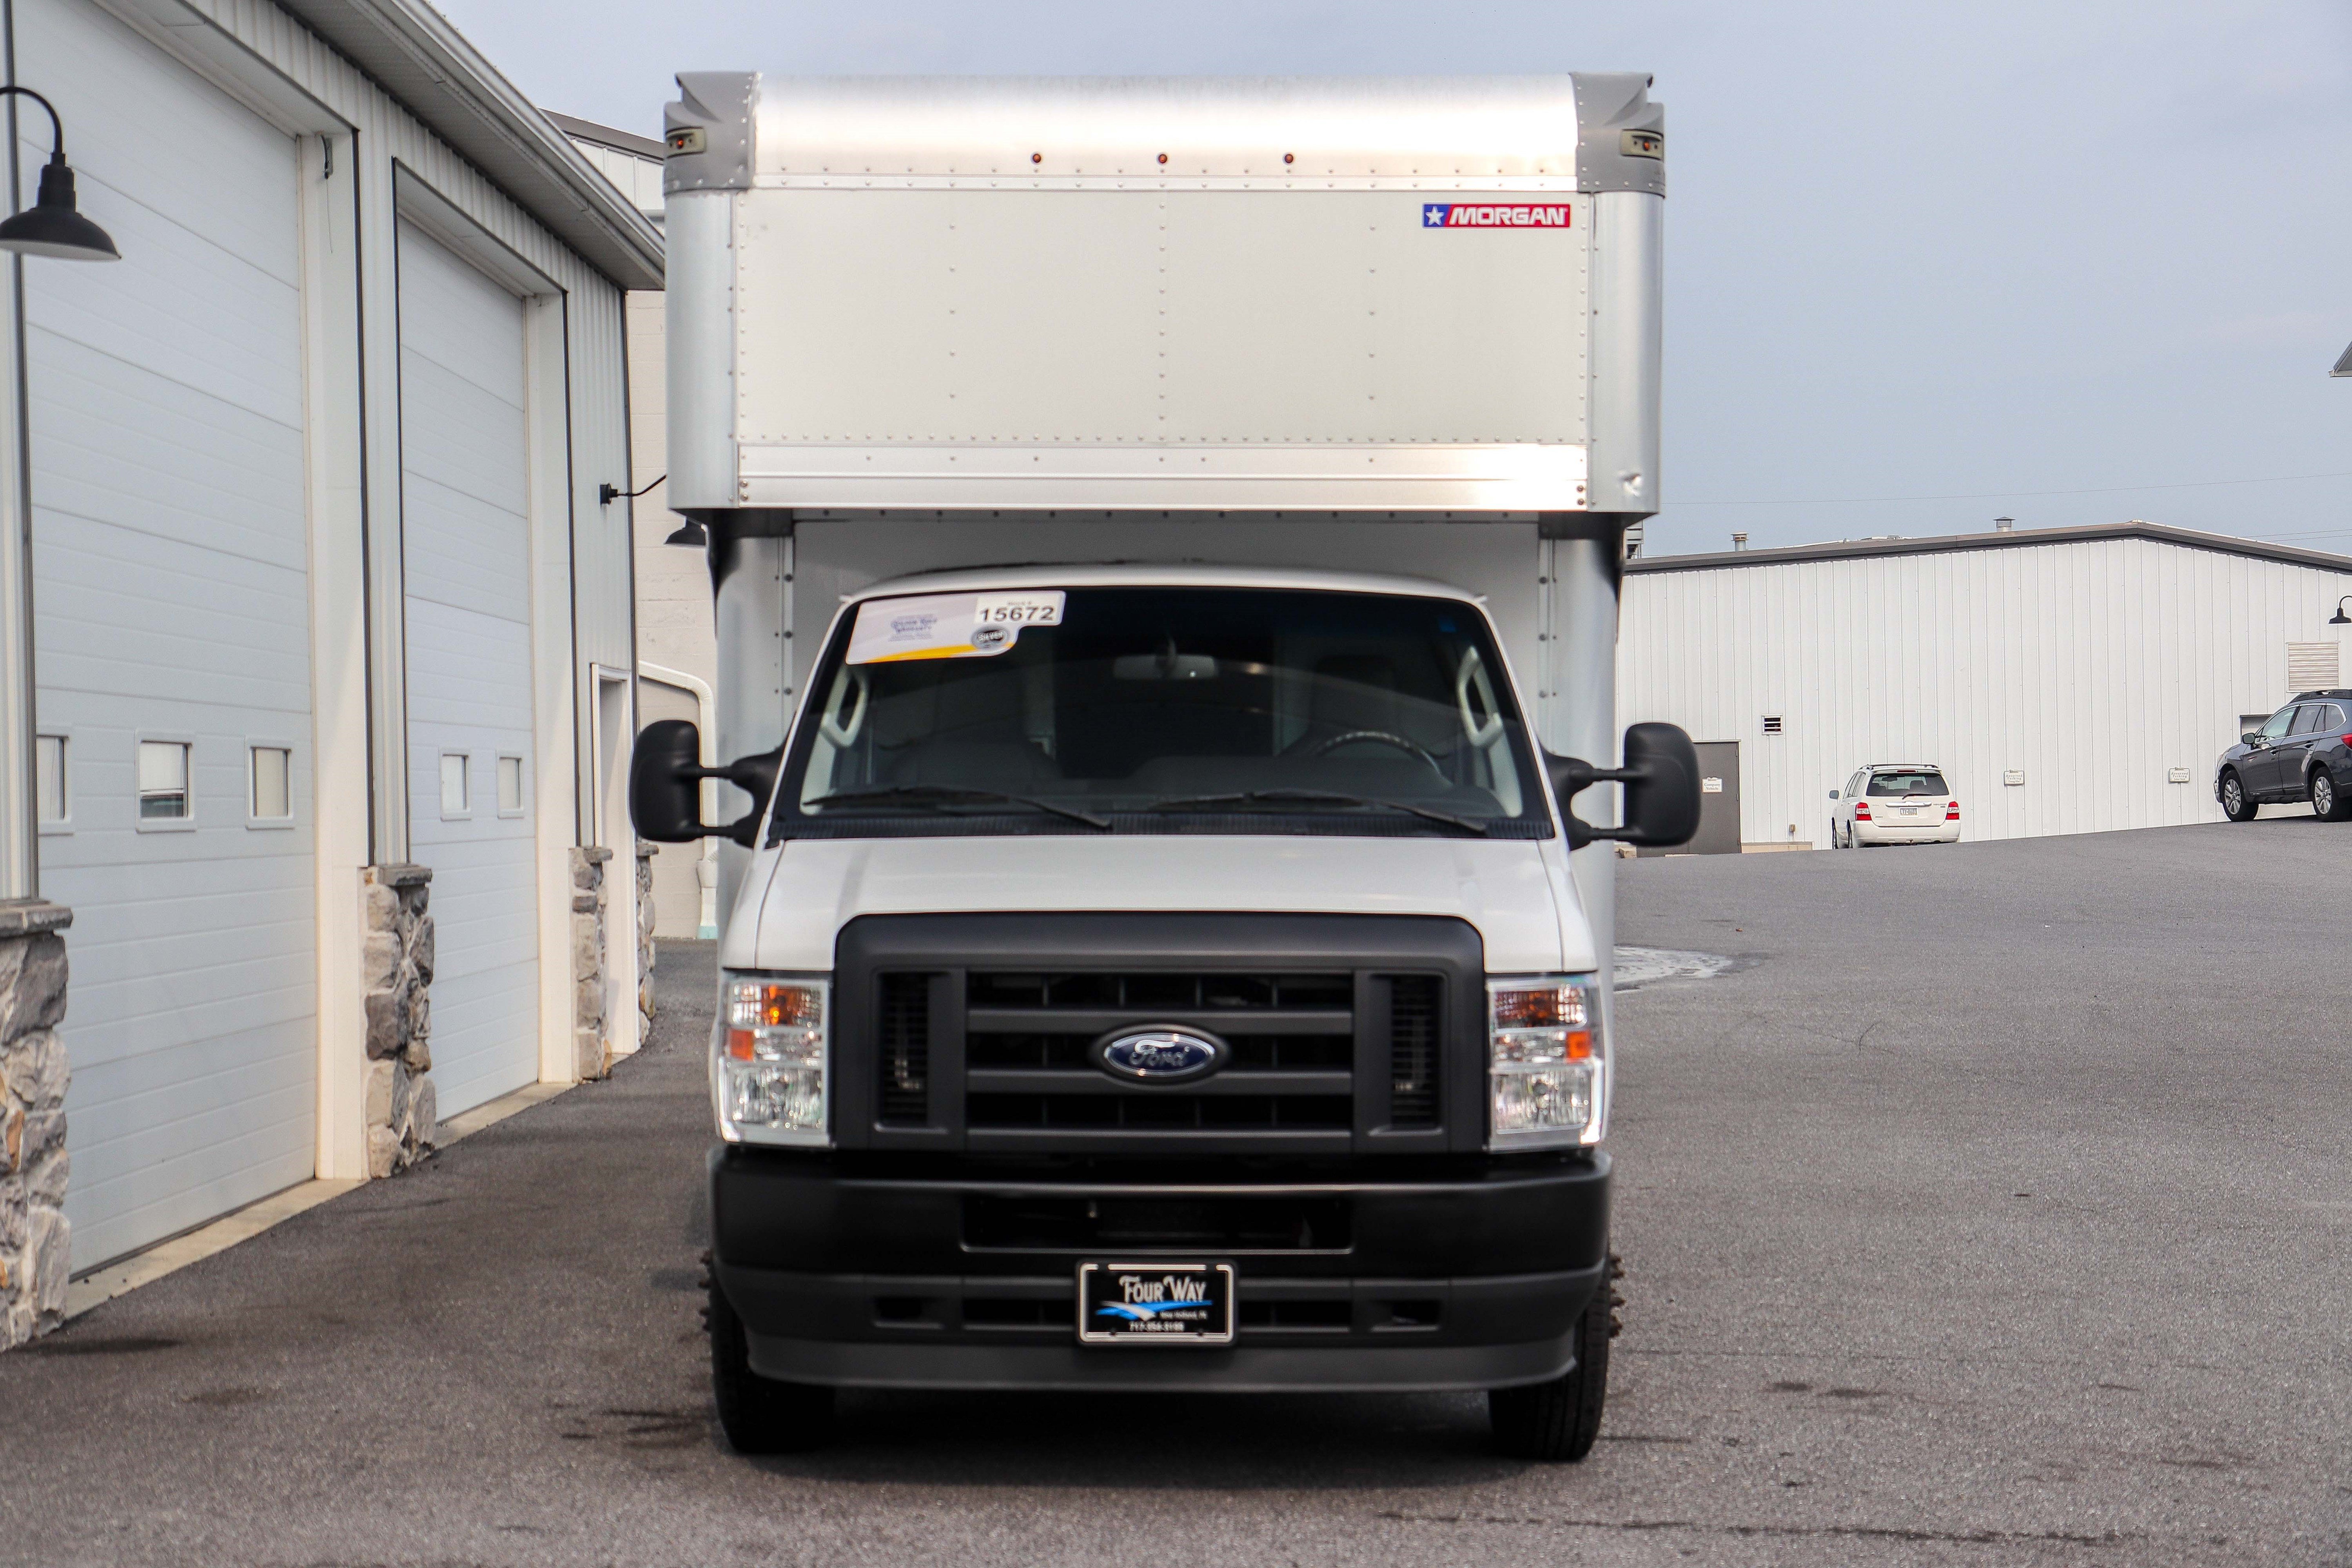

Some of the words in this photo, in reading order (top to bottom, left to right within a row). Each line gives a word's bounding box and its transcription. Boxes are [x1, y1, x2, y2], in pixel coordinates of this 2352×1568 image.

[1448, 206, 1566, 225] MORGAN
[980, 605, 1054, 622] 15672
[1129, 1039, 1191, 1067] Ford
